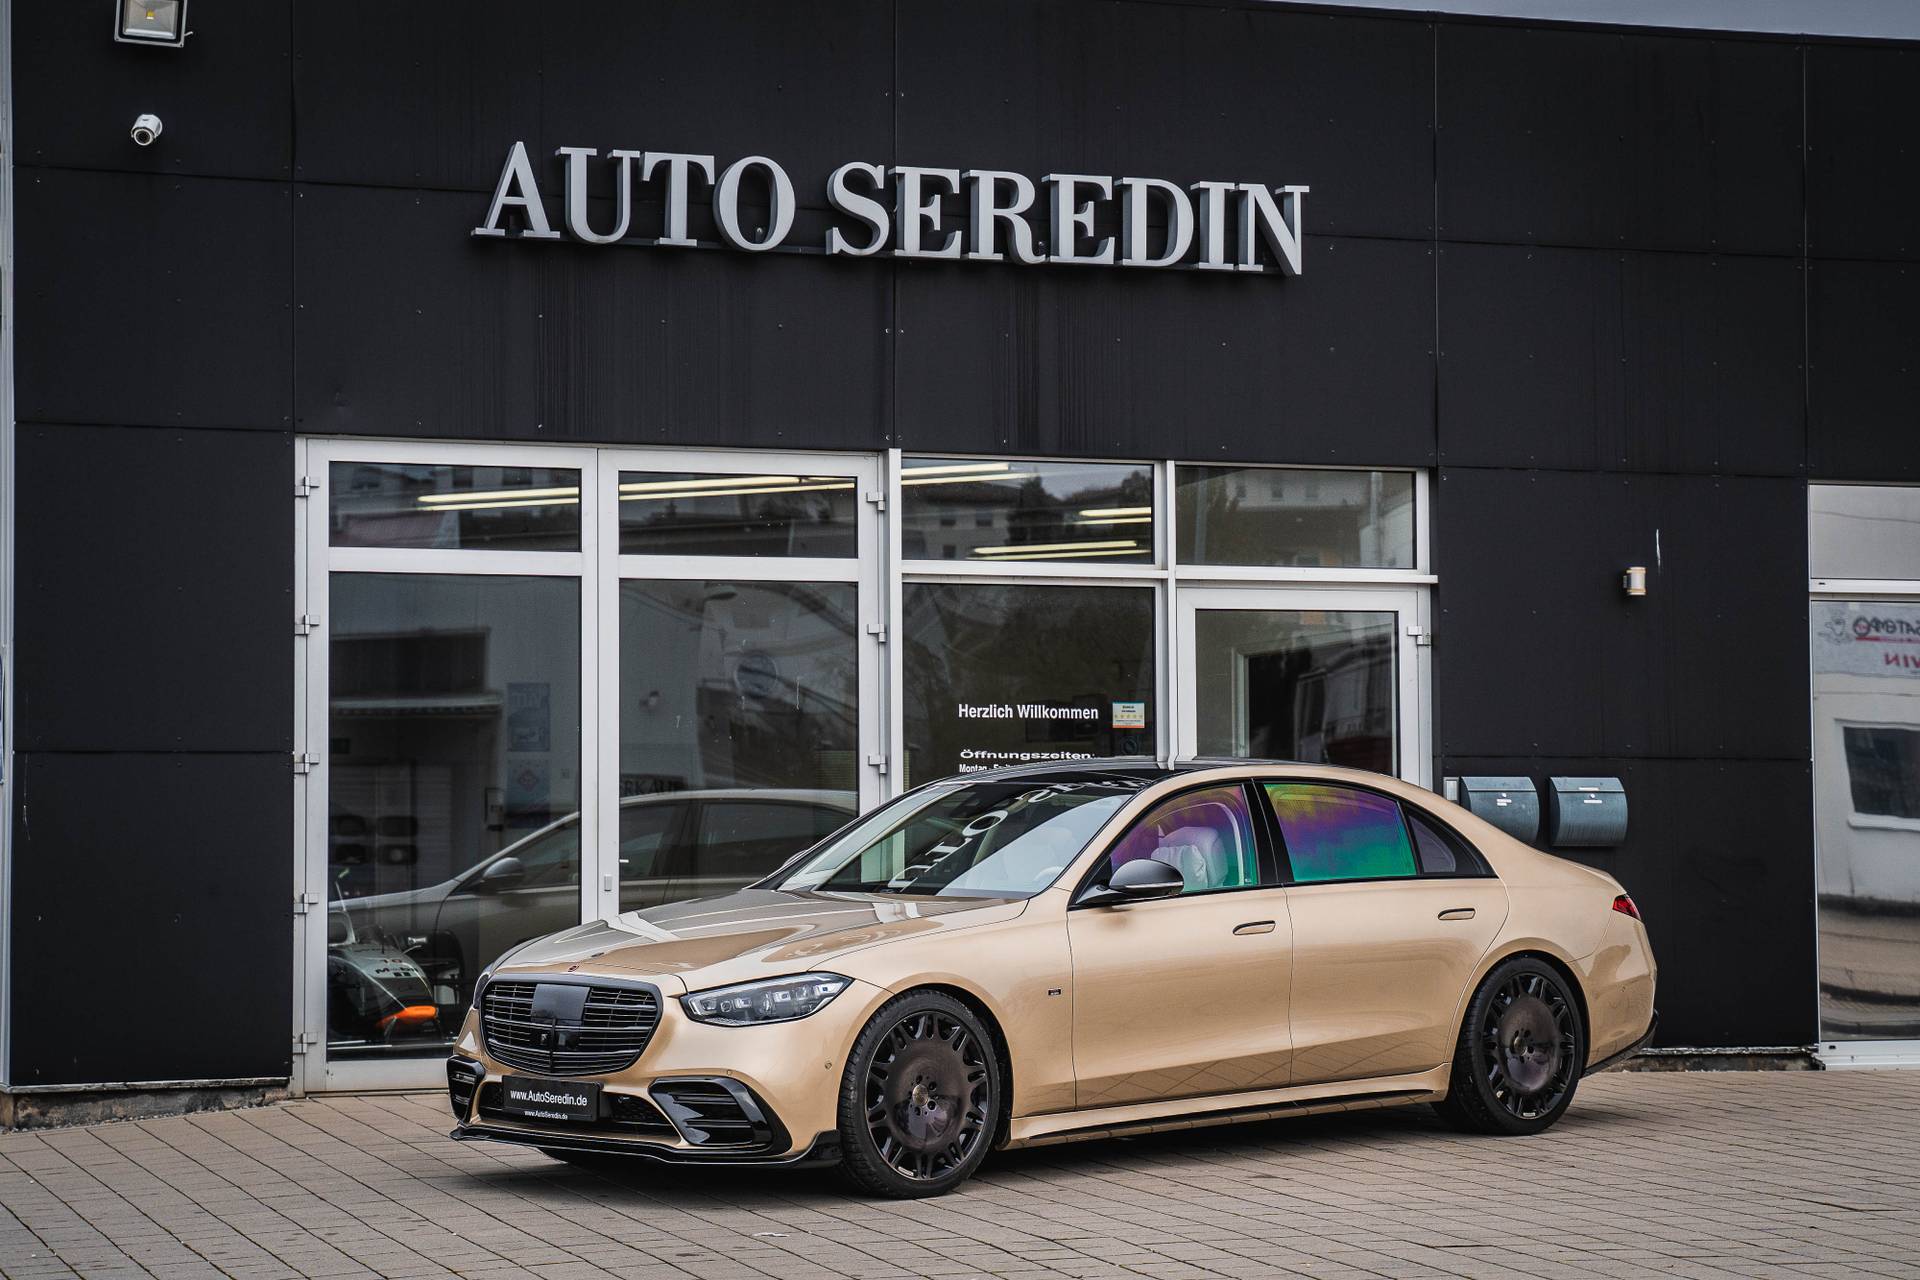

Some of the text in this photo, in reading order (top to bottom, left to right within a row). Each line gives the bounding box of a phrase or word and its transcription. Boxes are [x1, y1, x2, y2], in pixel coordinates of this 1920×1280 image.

[470, 140, 1311, 277] AUTO SEREDIN
[958, 703, 1099, 720] Herzlich Willkommen
[510, 1090, 587, 1106] www.AutoSeredin.de
[524, 1110, 568, 1120] www.AutoSeredin.de
